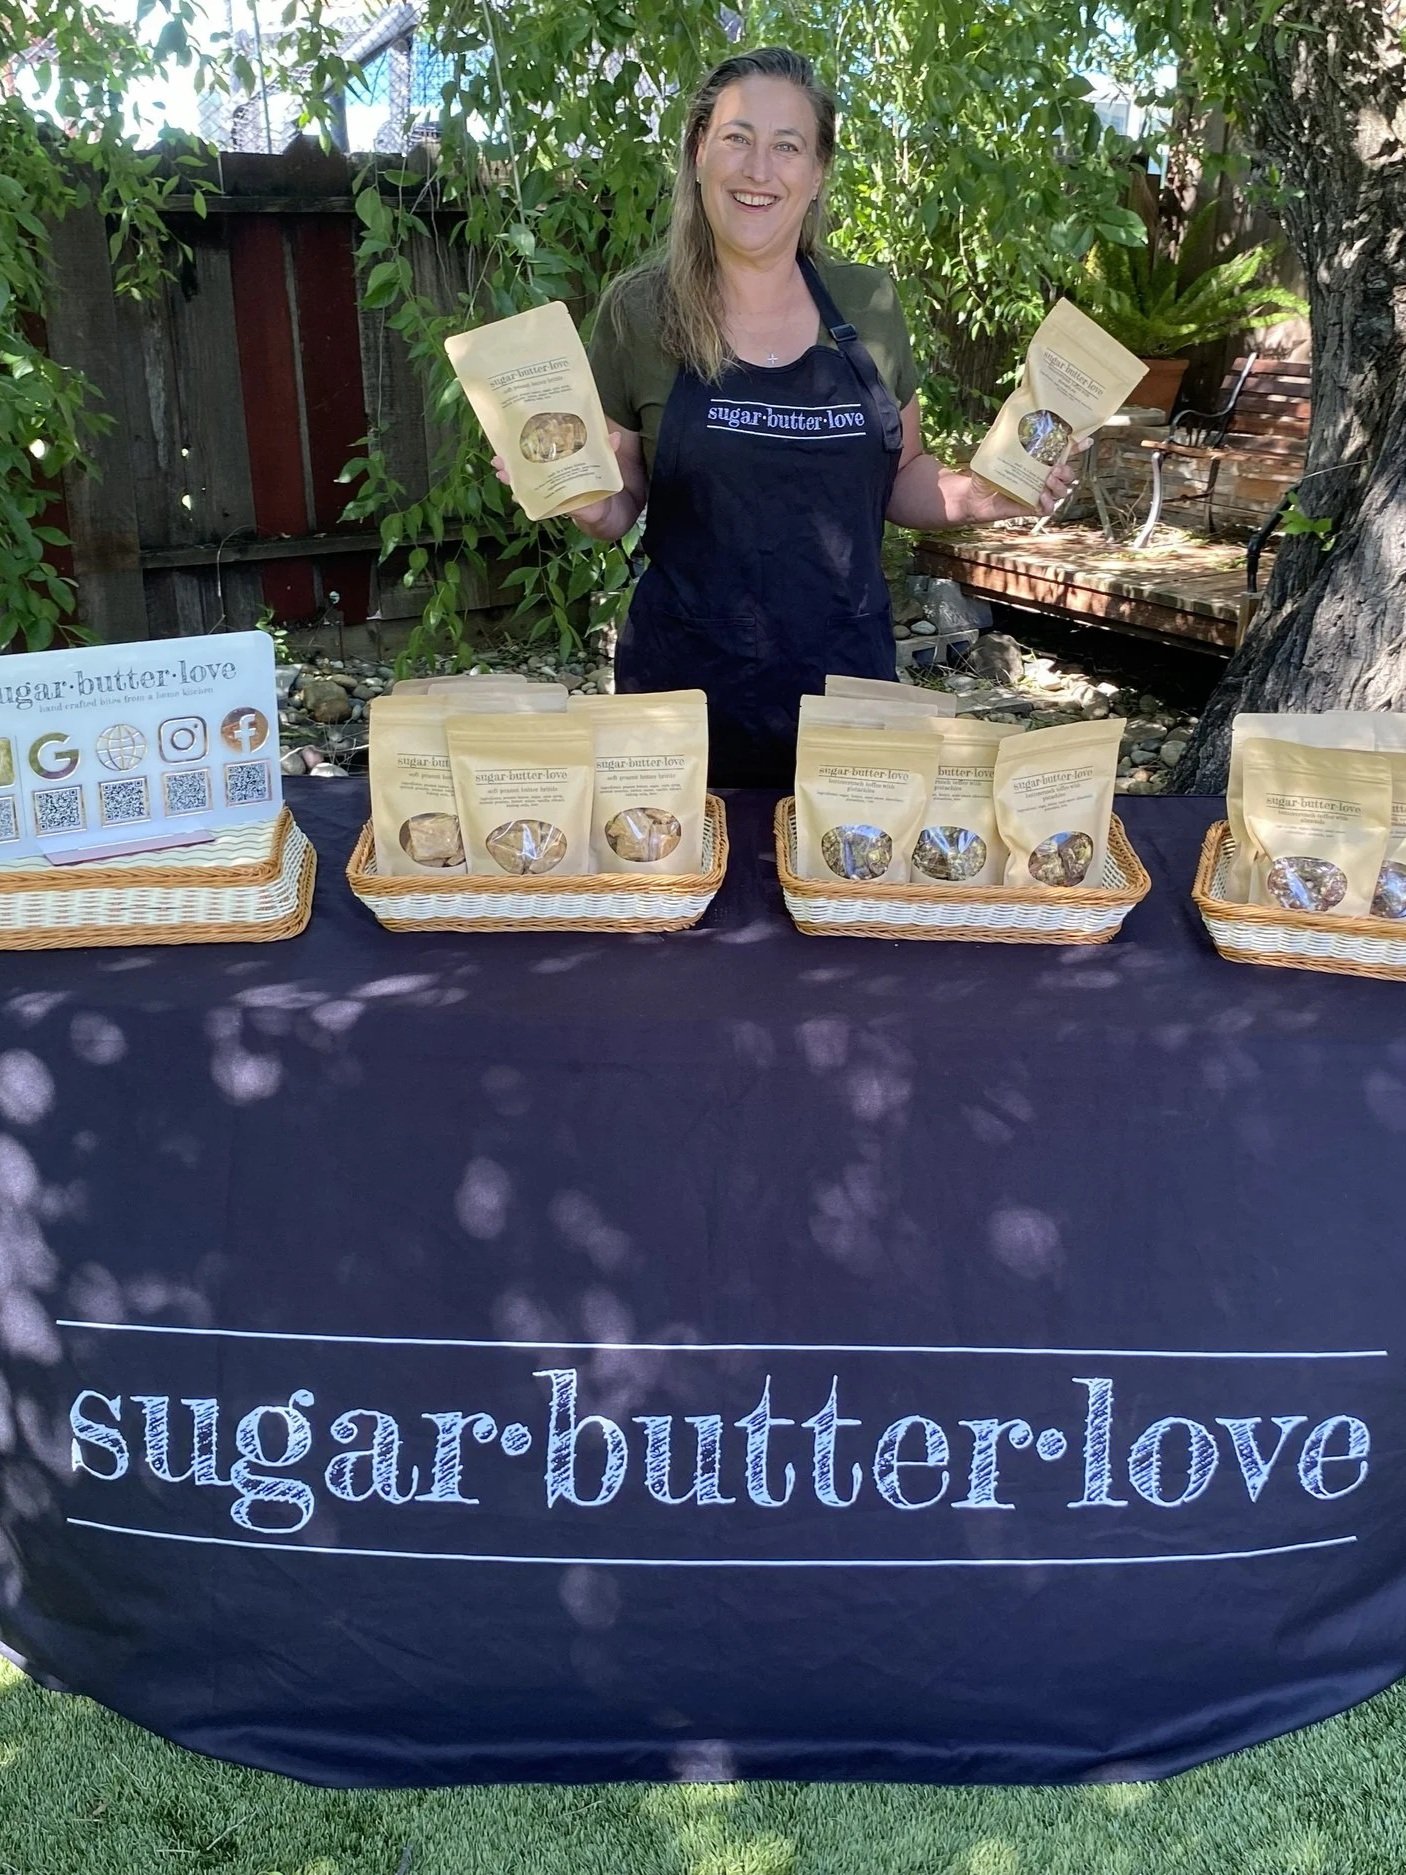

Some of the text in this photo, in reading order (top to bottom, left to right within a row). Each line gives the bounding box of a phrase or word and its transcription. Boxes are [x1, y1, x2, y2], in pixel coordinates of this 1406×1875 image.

[708, 406, 865, 431] sugar·butter·love
[0, 660, 237, 710] ugar·butter·love
[70, 1368, 1371, 1534] sugar·butter·love
